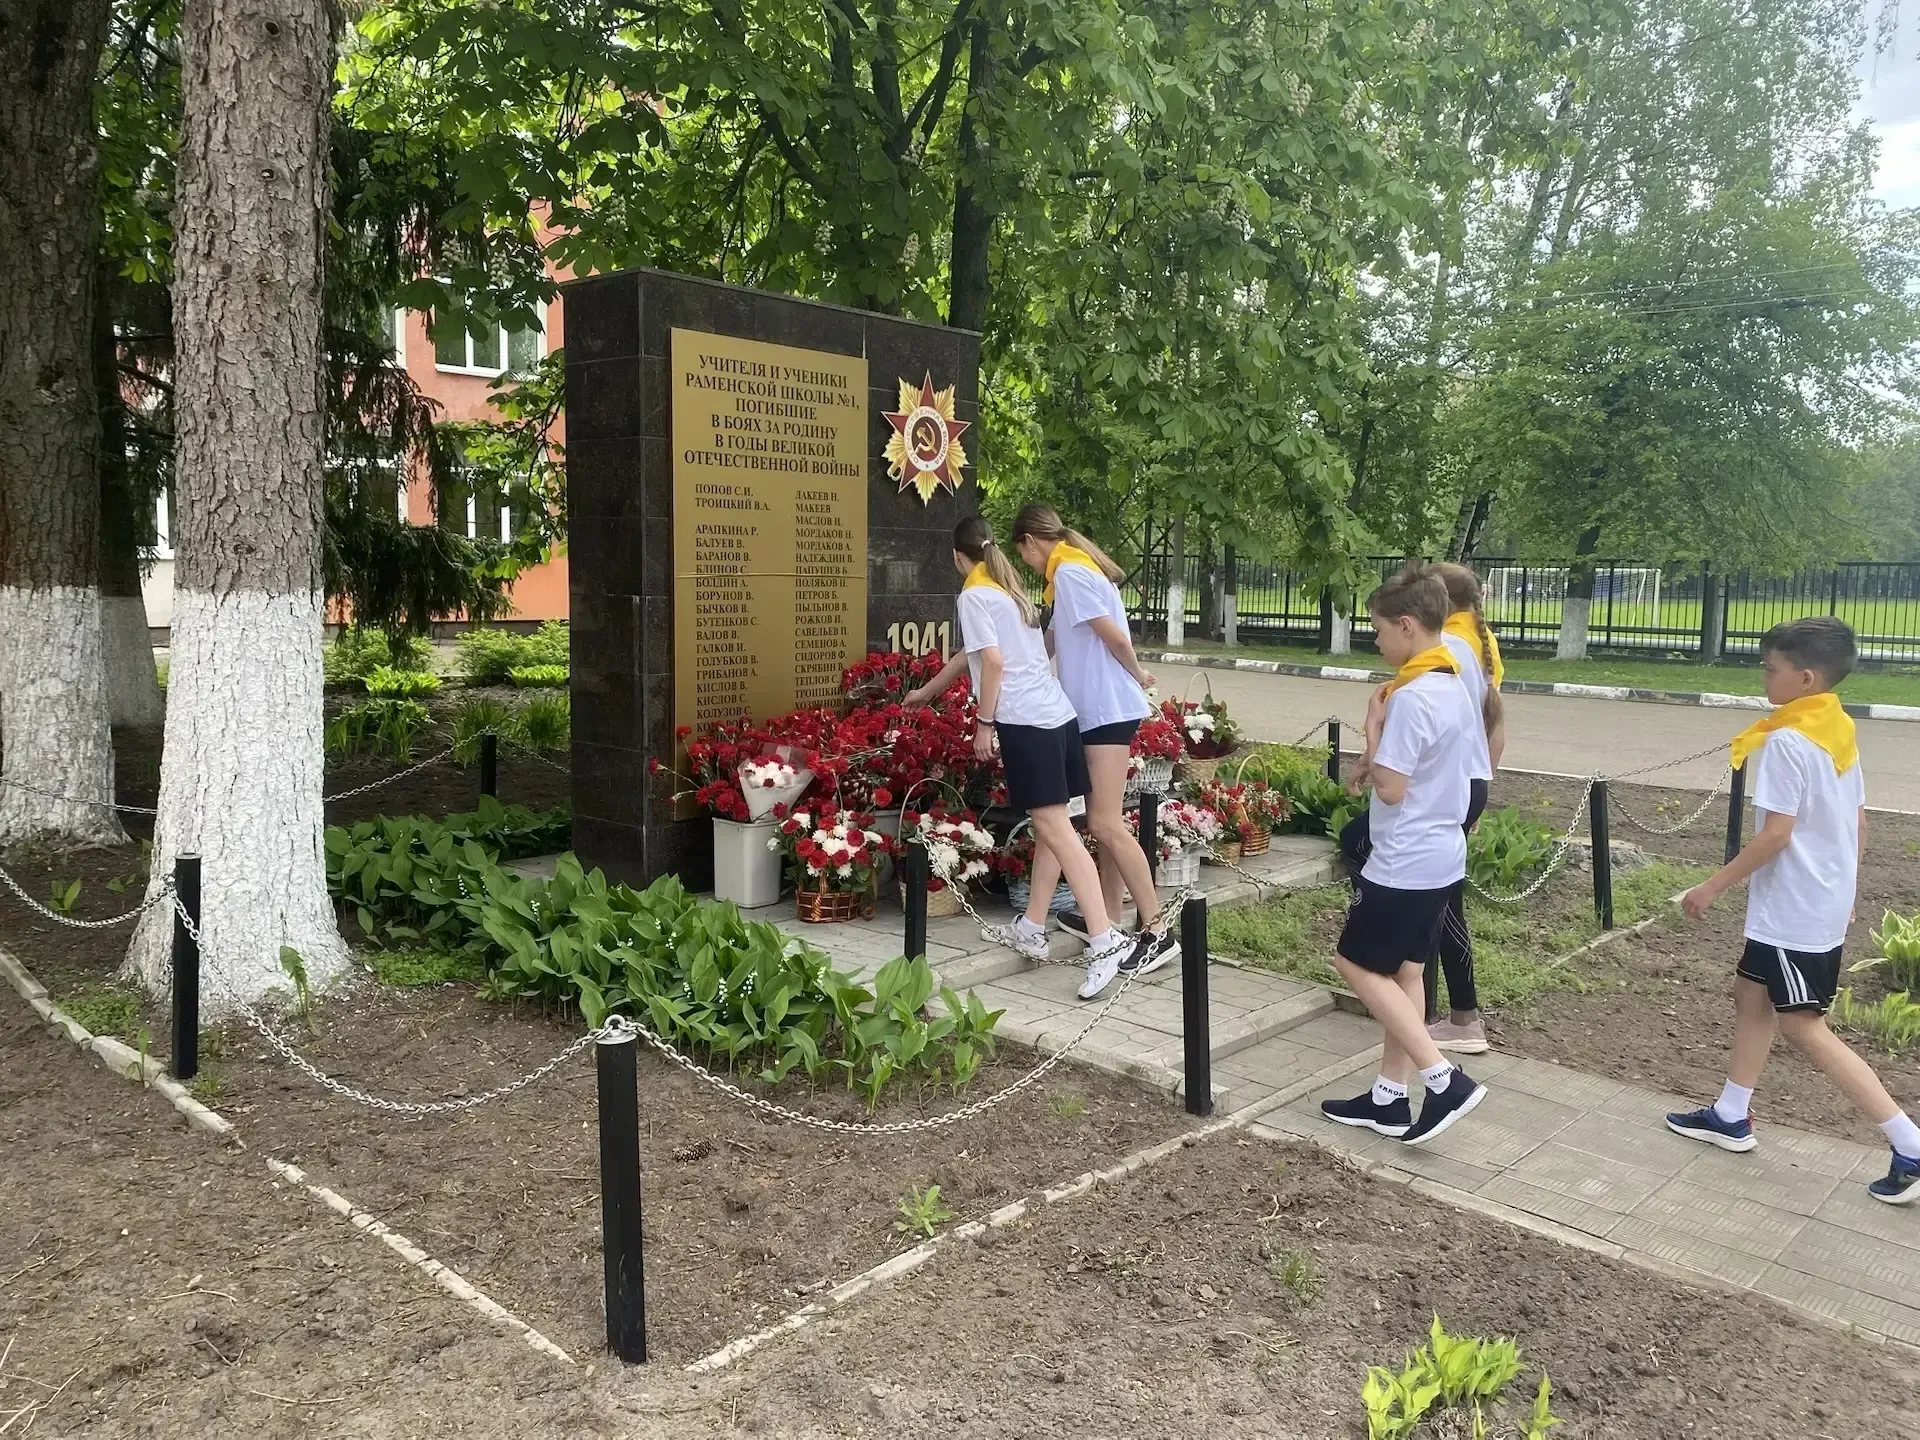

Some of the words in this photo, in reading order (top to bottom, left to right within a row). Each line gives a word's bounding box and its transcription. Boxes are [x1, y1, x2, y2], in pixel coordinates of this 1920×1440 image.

[699, 355, 766, 377] УЧИТЕЛЯ
[770, 365, 780, 378] И
[784, 367, 848, 389] УЧЕНИКИ
[685, 372, 776, 398] РАМЕНСКОЙ
[780, 386, 834, 405] ШКОЛЫ
[837, 393, 860, 411] №1,
[735, 398, 817, 420] ПОГИБШИЕ
[711, 414, 720, 428] В
[724, 415, 762, 432] БОЯХ
[765, 420, 780, 434] ЗА
[784, 423, 838, 440] РОДИНУ
[715, 433, 723, 448] В
[728, 435, 767, 452] ГОДЫ
[772, 440, 835, 458] ВЕЛИКОЙ
[684, 450, 808, 473] ОТЕЧЕСТВЕННОЙ
[812, 460, 860, 477] ВОЙНЫ
[695, 484, 732, 495] ПОПОВ
[795, 490, 829, 501] ЛАКЕЕВ
[695, 498, 751, 510] ТРОИЦКИЙ
[754, 501, 771, 511] В.А.
[795, 503, 831, 513] МАКЕЕВ
[795, 516, 833, 526] МАСЛОВ
[695, 524, 749, 535] АРАПКИНА
[751, 527, 759, 536] Р.
[795, 528, 843, 539] МОРДАКОВ
[696, 538, 734, 548] БАЛУЕВ
[736, 539, 745, 549] В.
[795, 540, 843, 551] МОРДАКОВ
[696, 551, 741, 561] БАРАНОВ
[743, 552, 752, 562] В.
[795, 553, 845, 563] НАДЕЖДИН
[847, 554, 855, 563] В.
[696, 564, 738, 574] БЛИНОВ
[696, 577, 738, 588] БОЛДИН
[740, 579, 749, 588] А.
[795, 578, 838, 588] ПОЛЯКОВ
[696, 591, 743, 601] БОРУНОВ
[745, 591, 754, 600] В.
[795, 590, 830, 600] ПЕТРОВ
[696, 604, 739, 614] БЫЧКОВ
[741, 604, 750, 613] В.
[795, 603, 840, 612] ПЫЛЬНОВ
[842, 602, 849, 612] В.
[696, 617, 748, 627] БУТЕНКОВ
[750, 617, 760, 626] С.
[795, 615, 833, 625] РОЖКОВ
[696, 630, 729, 641] ВАЛОВ
[731, 630, 740, 639] В.
[795, 627, 839, 637] САВЕЛЬЕВ
[696, 643, 734, 653] ГАЛКОВ
[794, 639, 838, 649] СЕМЕНОВ
[839, 639, 847, 648] А.
[887, 621, 950, 664] 1941
[696, 656, 748, 667] ГОЛУБКОВ
[750, 655, 759, 664] В.
[795, 651, 837, 661] СИДОРОВ
[838, 650, 848, 659] Ф.
[696, 668, 748, 680] ГРИБАНОВ
[750, 668, 758, 677] А.
[795, 663, 836, 674] СКРЯБИН
[794, 675, 830, 686] ТЕПЛОВ
[696, 681, 737, 693] КИСЛОВ
[739, 681, 748, 690] В.
[696, 694, 737, 706] КИСЛОВ
[739, 694, 748, 703] С.
[697, 707, 742, 719] КОЛУЗОВ
[1379, 1084, 1405, 1097] ERROR
